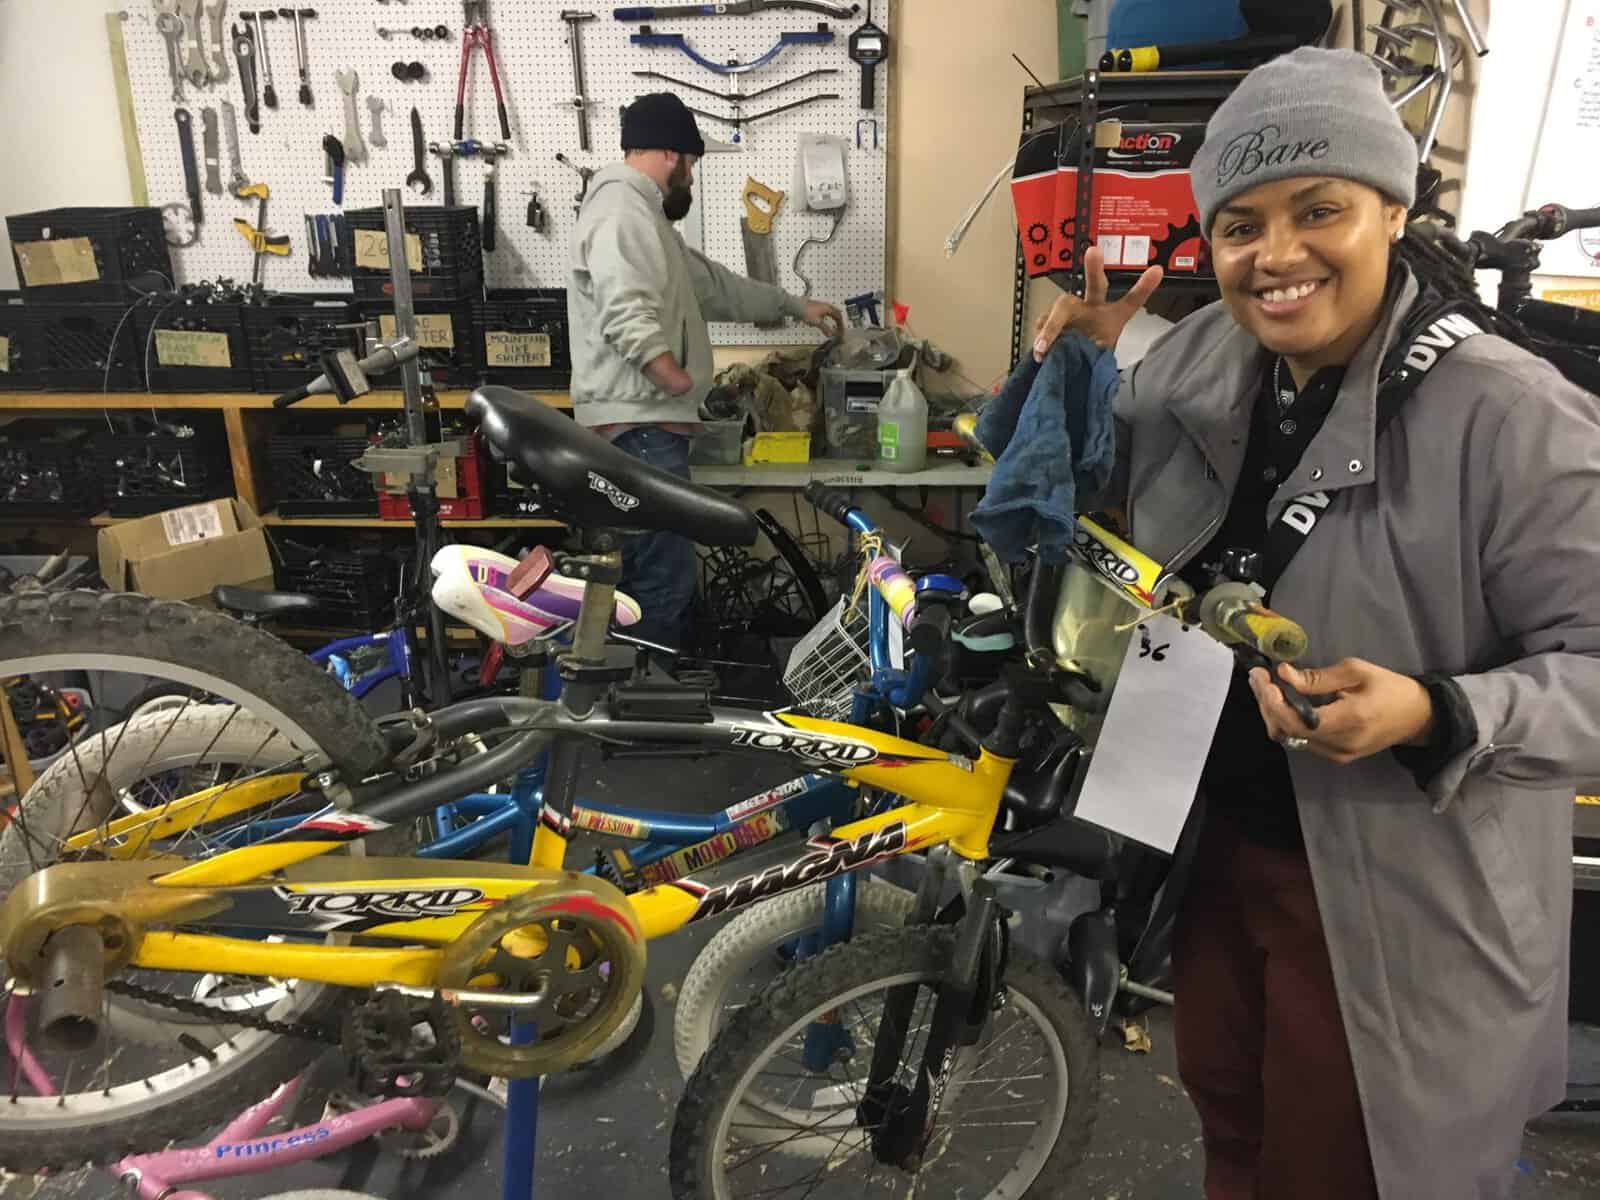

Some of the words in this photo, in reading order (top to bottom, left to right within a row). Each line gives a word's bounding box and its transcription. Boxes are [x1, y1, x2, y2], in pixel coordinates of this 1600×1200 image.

[1119, 133, 1174, 150] ction
[1217, 125, 1329, 188] Bare
[490, 335, 547, 344] MOUNTAIN
[1404, 314, 1484, 372] DVM
[587, 472, 640, 511] TORRID
[1073, 528, 1140, 584] ORRID
[728, 721, 879, 768] TORRID
[688, 821, 906, 921] MAGNA
[288, 888, 484, 917] TORRID
[216, 1127, 329, 1158] Princess
